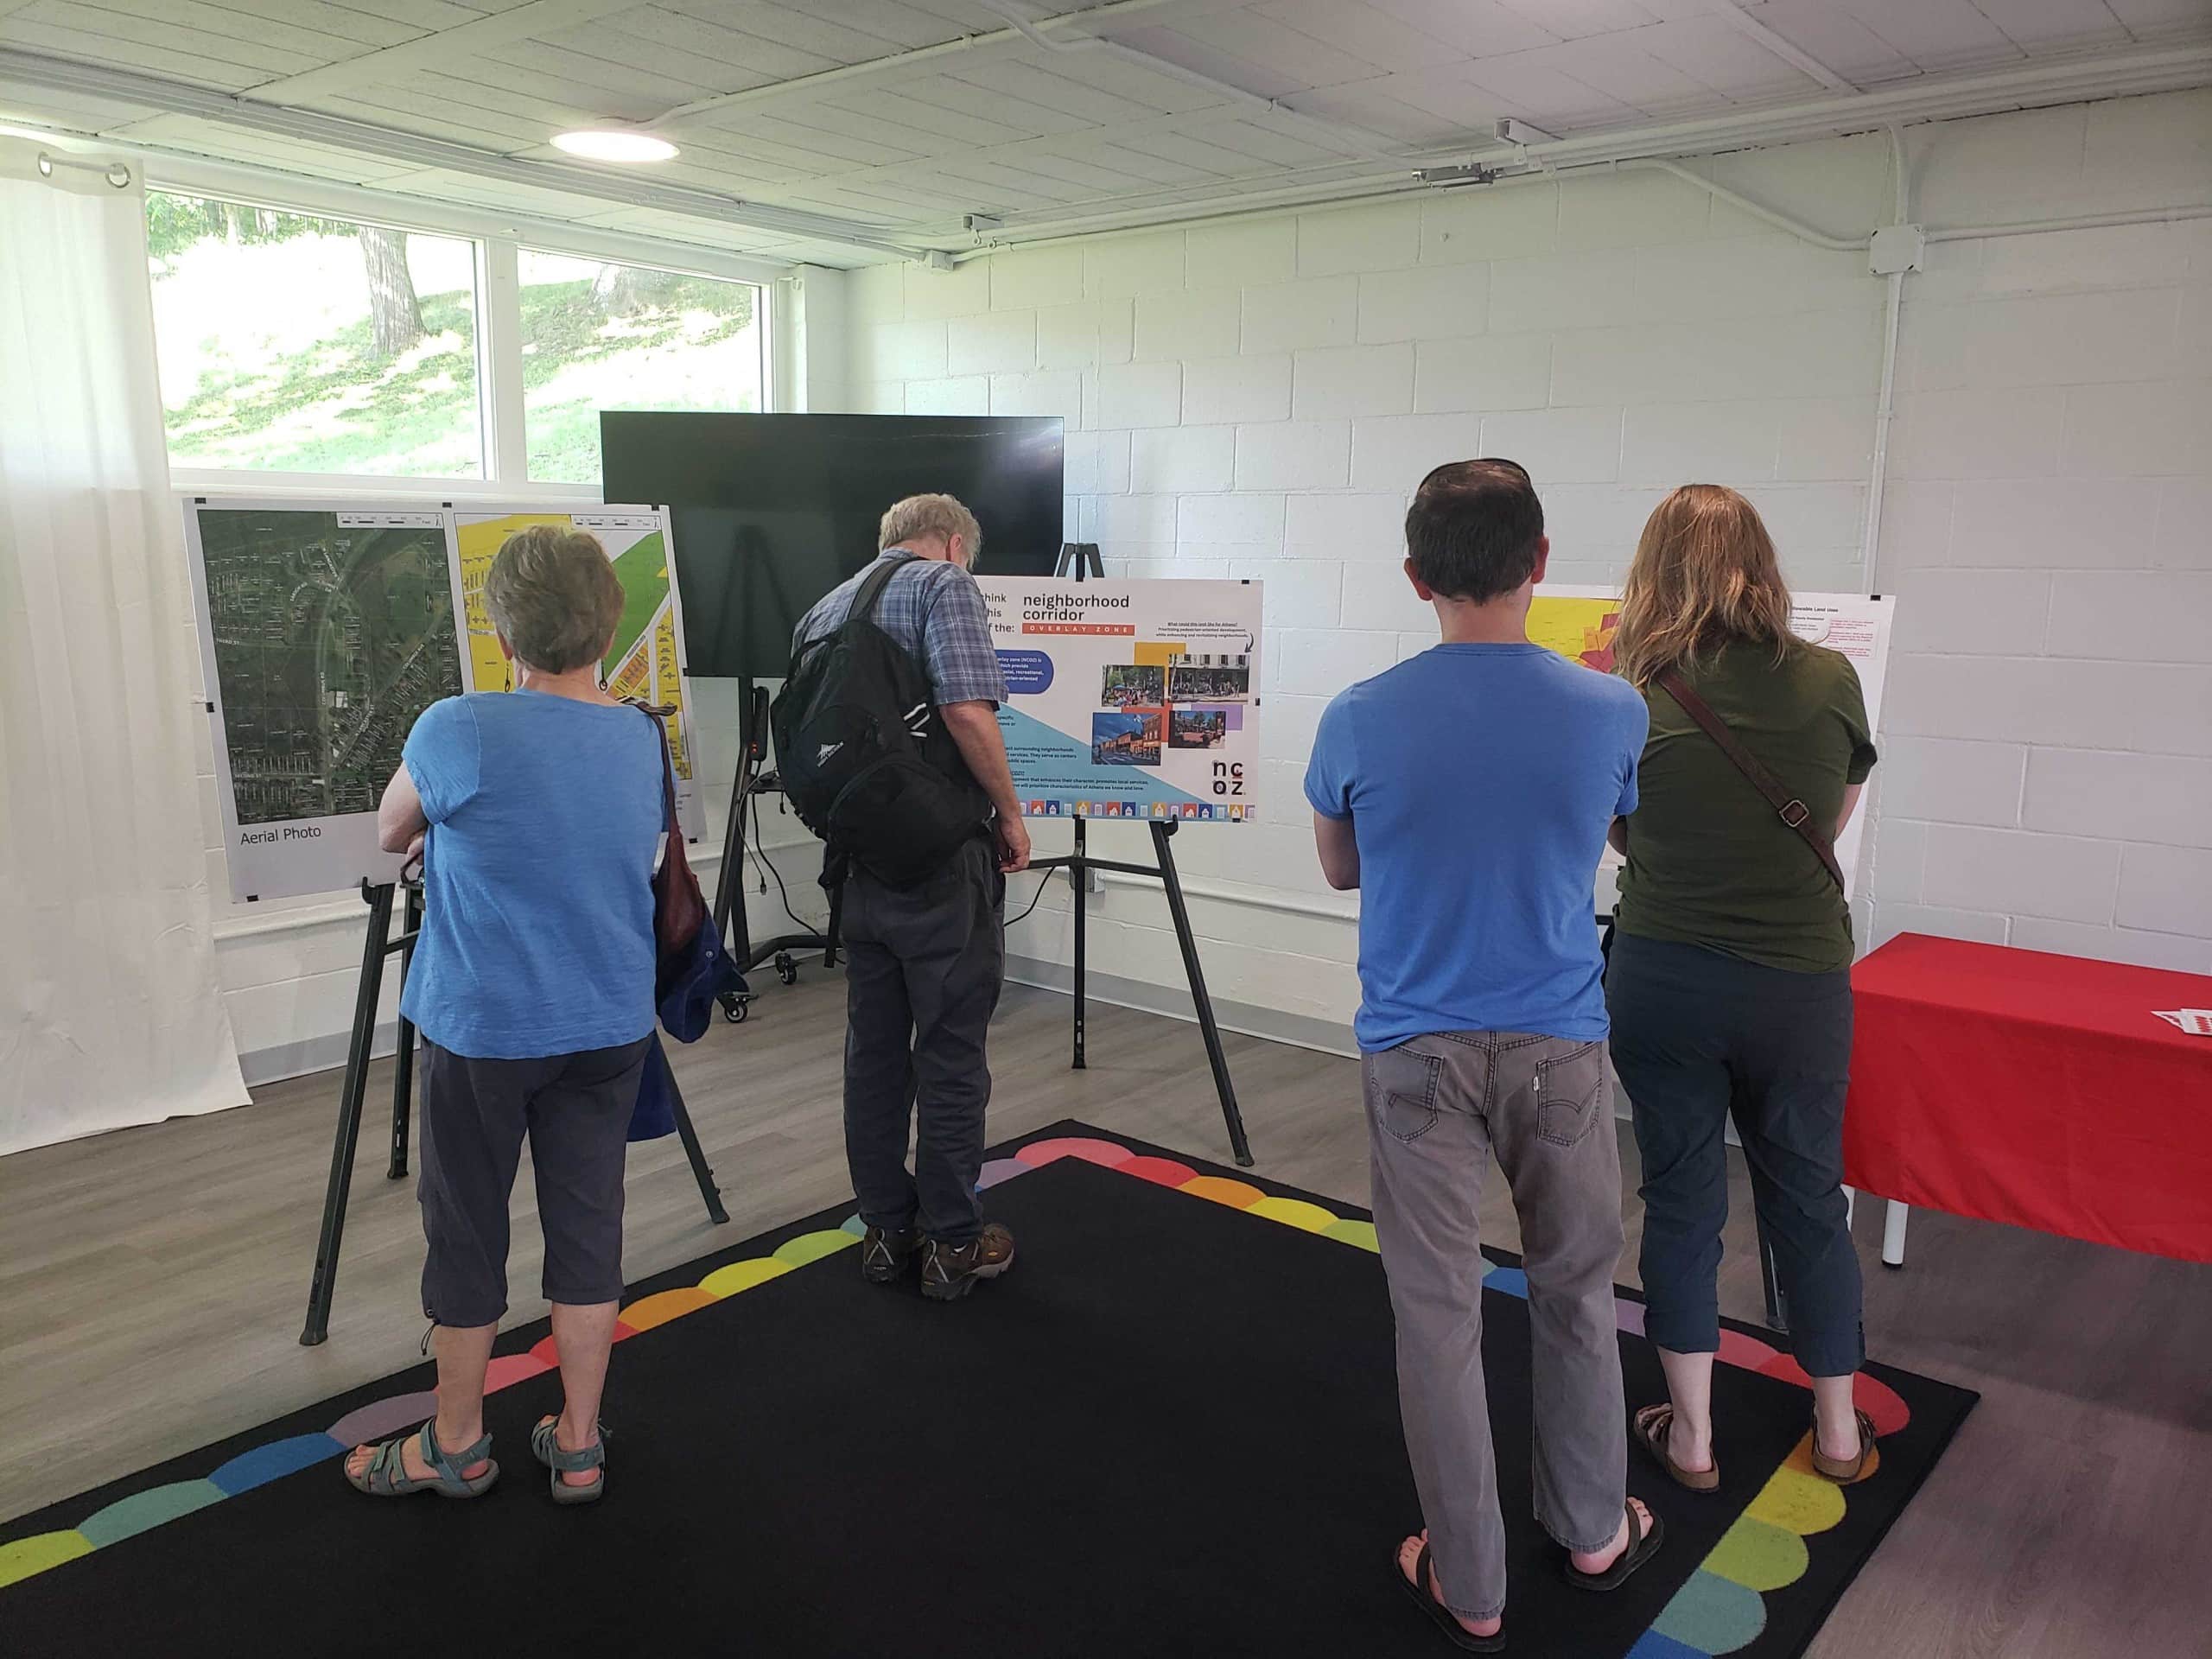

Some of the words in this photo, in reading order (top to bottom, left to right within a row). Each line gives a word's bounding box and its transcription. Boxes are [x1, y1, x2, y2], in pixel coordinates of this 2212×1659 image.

[1023, 594, 1129, 609] neighborhood
[987, 608, 1002, 618] his
[1023, 608, 1084, 621] corridor
[988, 623, 994, 632] f
[995, 623, 1015, 632] the:
[240, 830, 279, 845] Aerial
[283, 826, 321, 841] Photo
